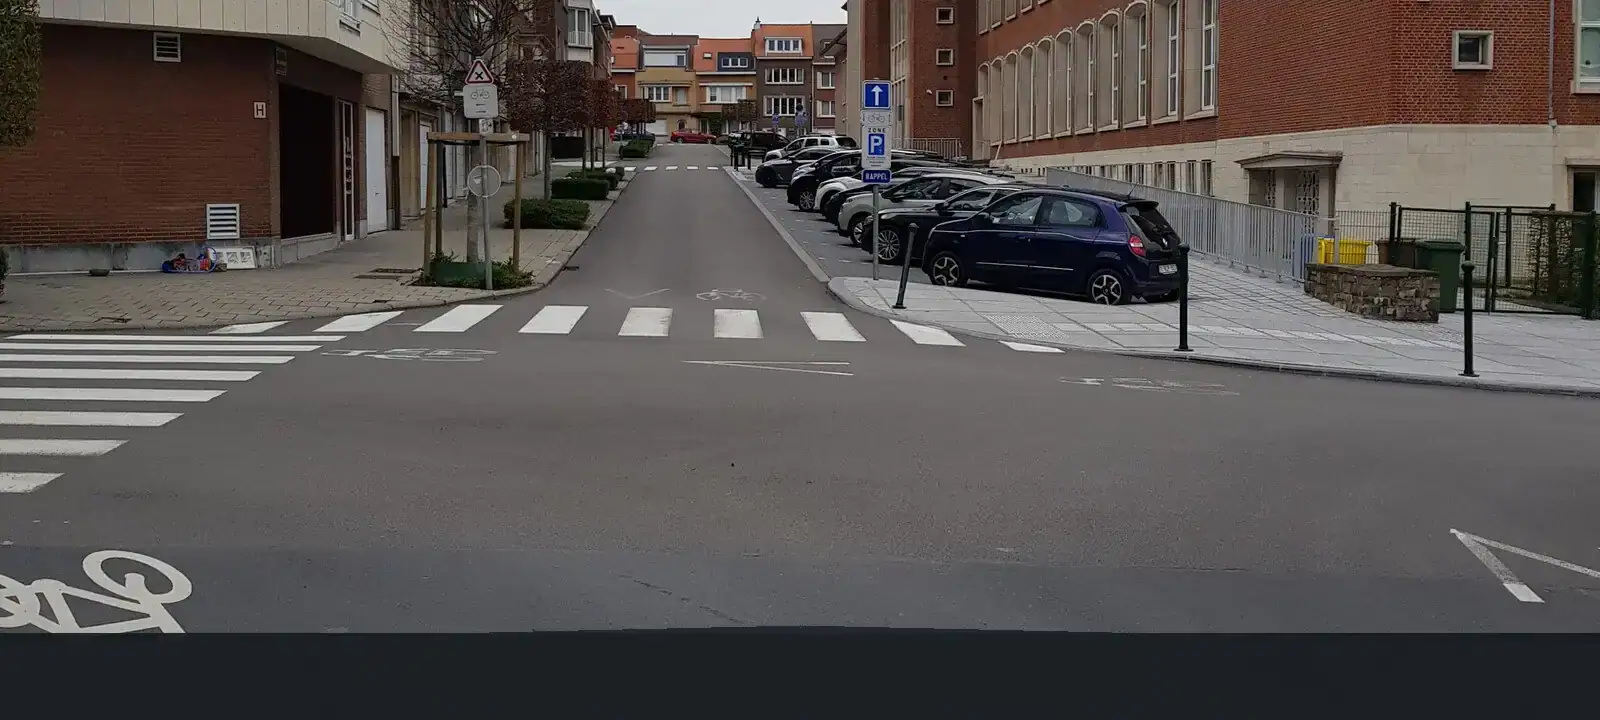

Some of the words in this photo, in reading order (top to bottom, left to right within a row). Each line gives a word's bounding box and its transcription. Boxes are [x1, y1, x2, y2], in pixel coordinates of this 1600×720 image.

[256, 103, 264, 116] H
[870, 135, 883, 154] P
[865, 172, 888, 181] RAPPEL
